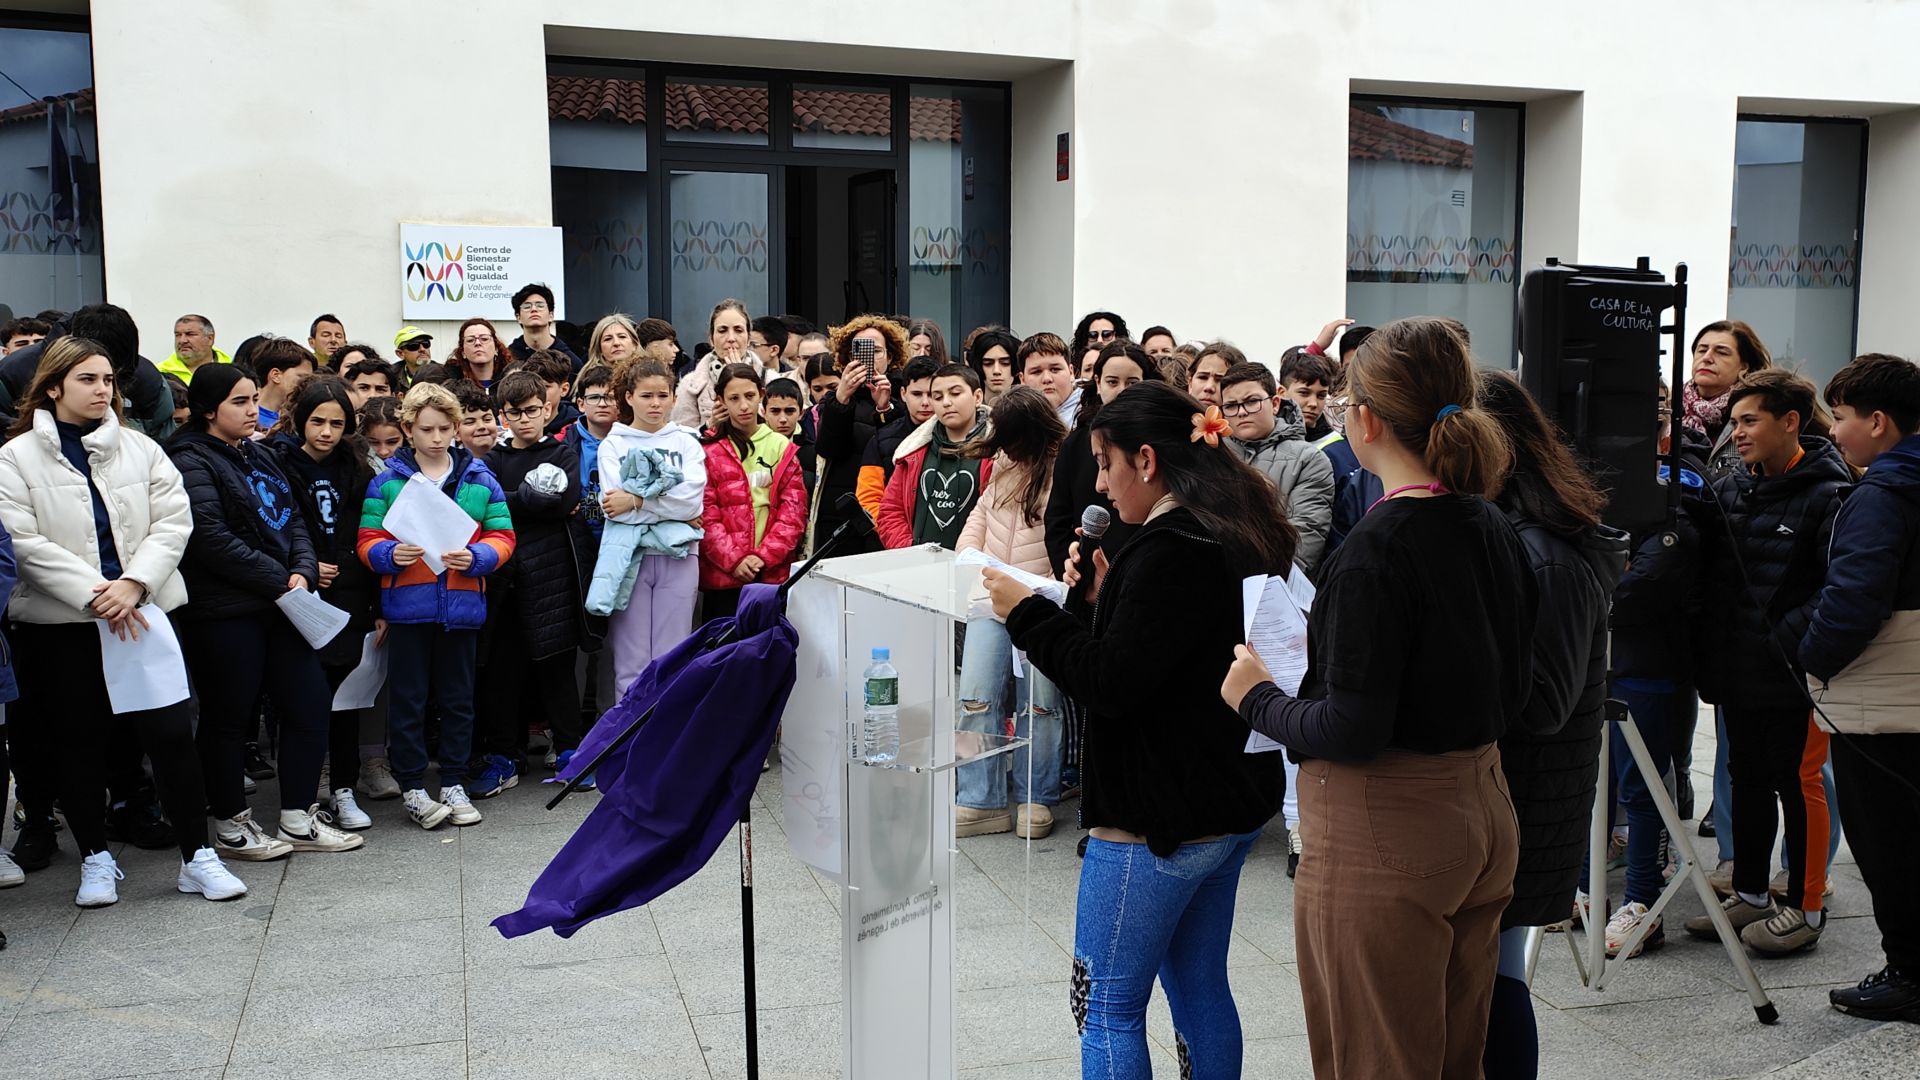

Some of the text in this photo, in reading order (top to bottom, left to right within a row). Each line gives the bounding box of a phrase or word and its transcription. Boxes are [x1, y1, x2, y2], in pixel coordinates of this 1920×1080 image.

[466, 245, 498, 253] Centro
[466, 254, 511, 262] Bienestar
[466, 263, 496, 271] Social
[467, 272, 508, 281] Igualdad
[468, 283, 502, 291] Valverde
[467, 291, 478, 299] de
[1589, 297, 1653, 316] CASA DE LA
[1602, 313, 1655, 333] CULTURA
